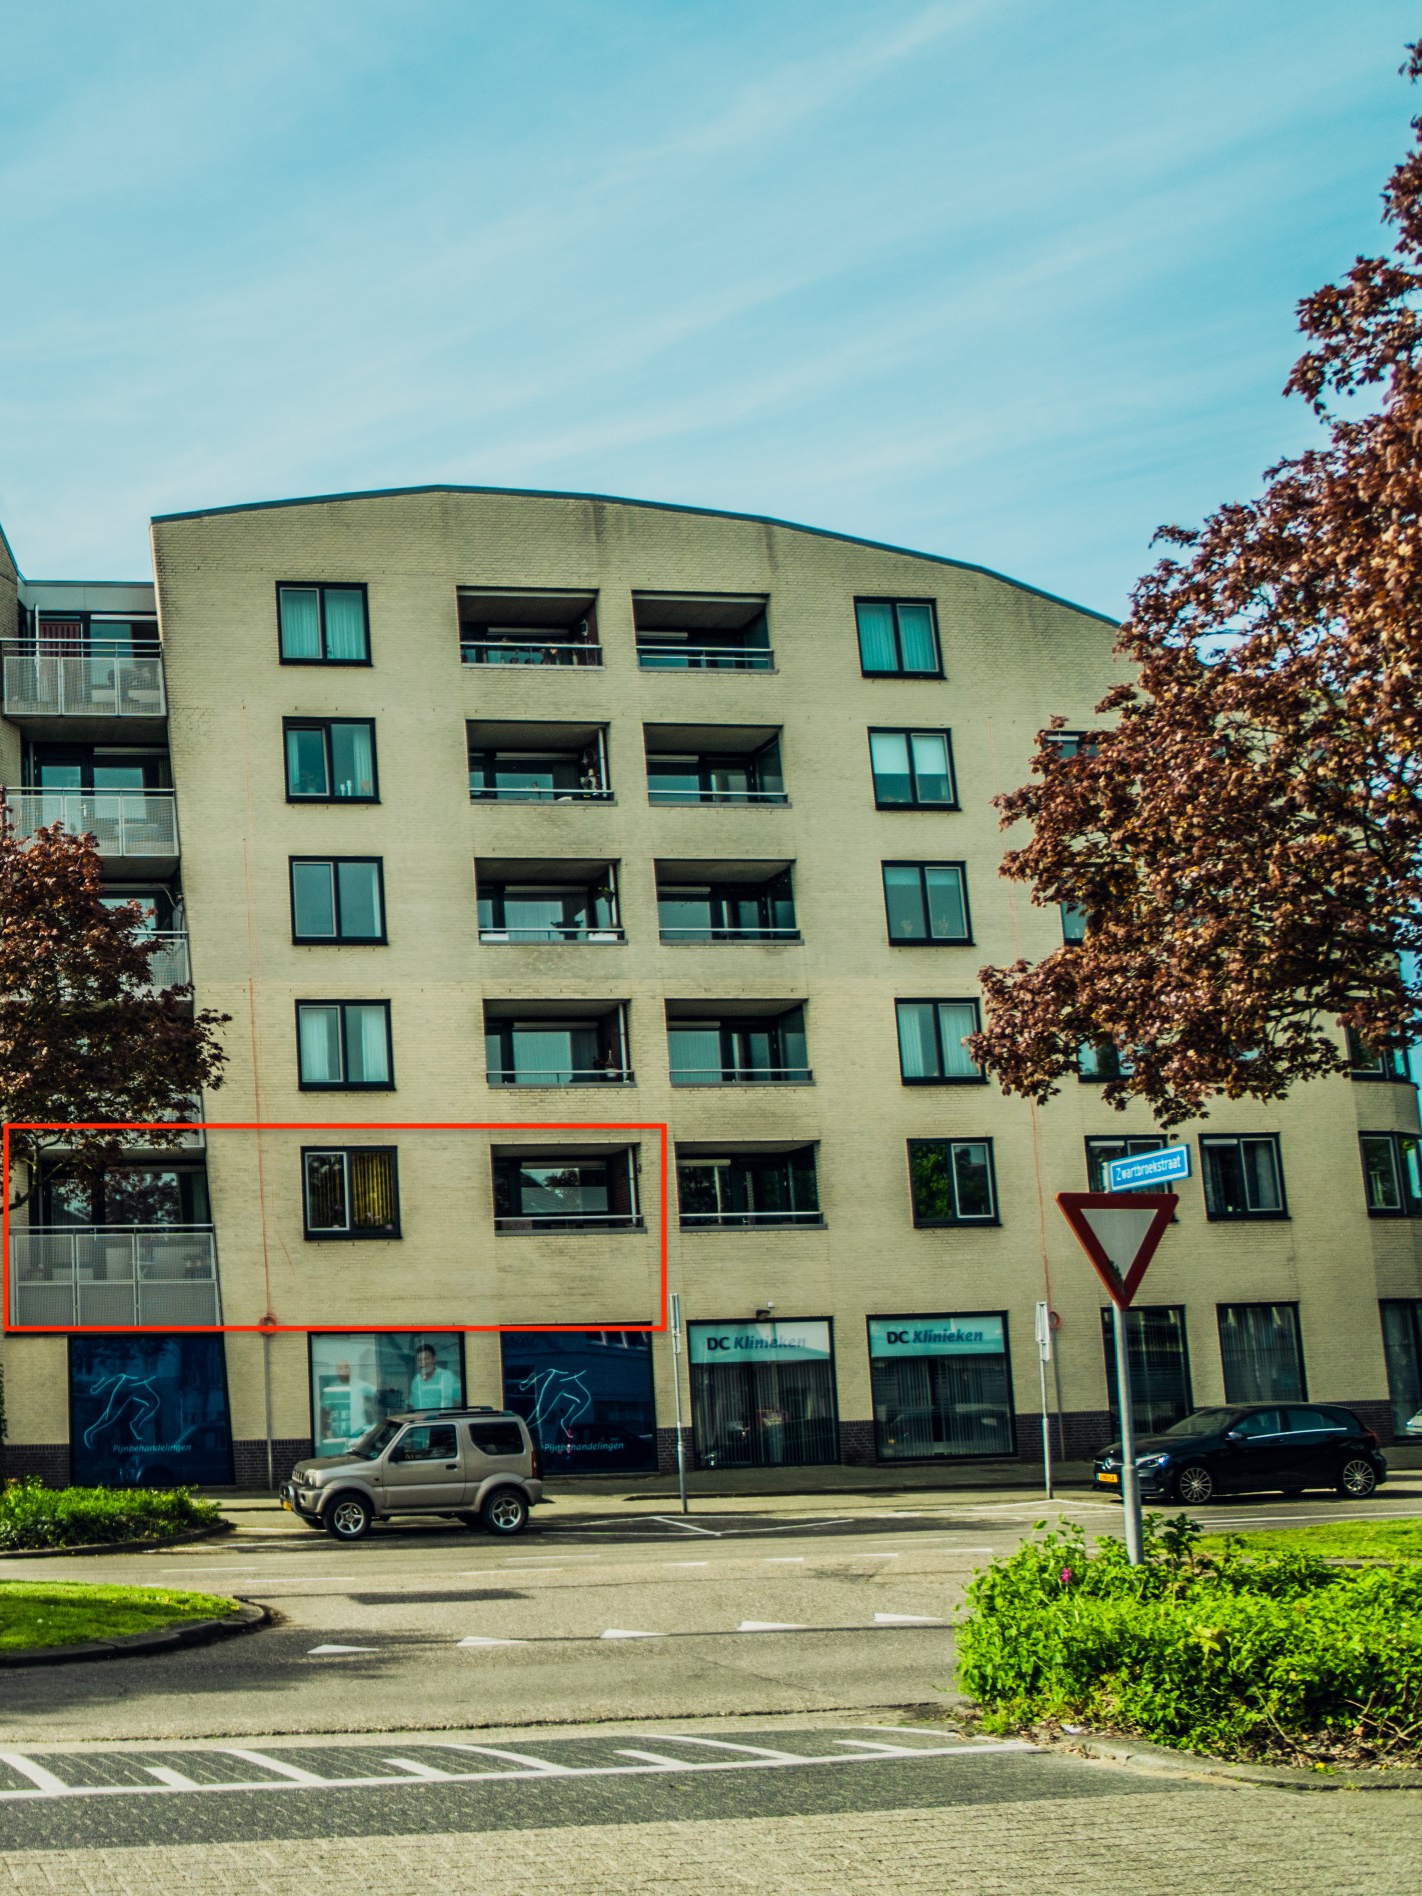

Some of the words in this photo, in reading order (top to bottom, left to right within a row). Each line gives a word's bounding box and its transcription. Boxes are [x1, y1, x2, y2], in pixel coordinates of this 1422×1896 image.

[1115, 1154, 1181, 1180] Zwartbroekstraat
[706, 1336, 729, 1350] DC
[733, 1335, 806, 1349] Klinieken
[886, 1331, 909, 1344] DC
[912, 1329, 983, 1343] Klinieken
[112, 1443, 191, 1454] Pijnbehandelingen
